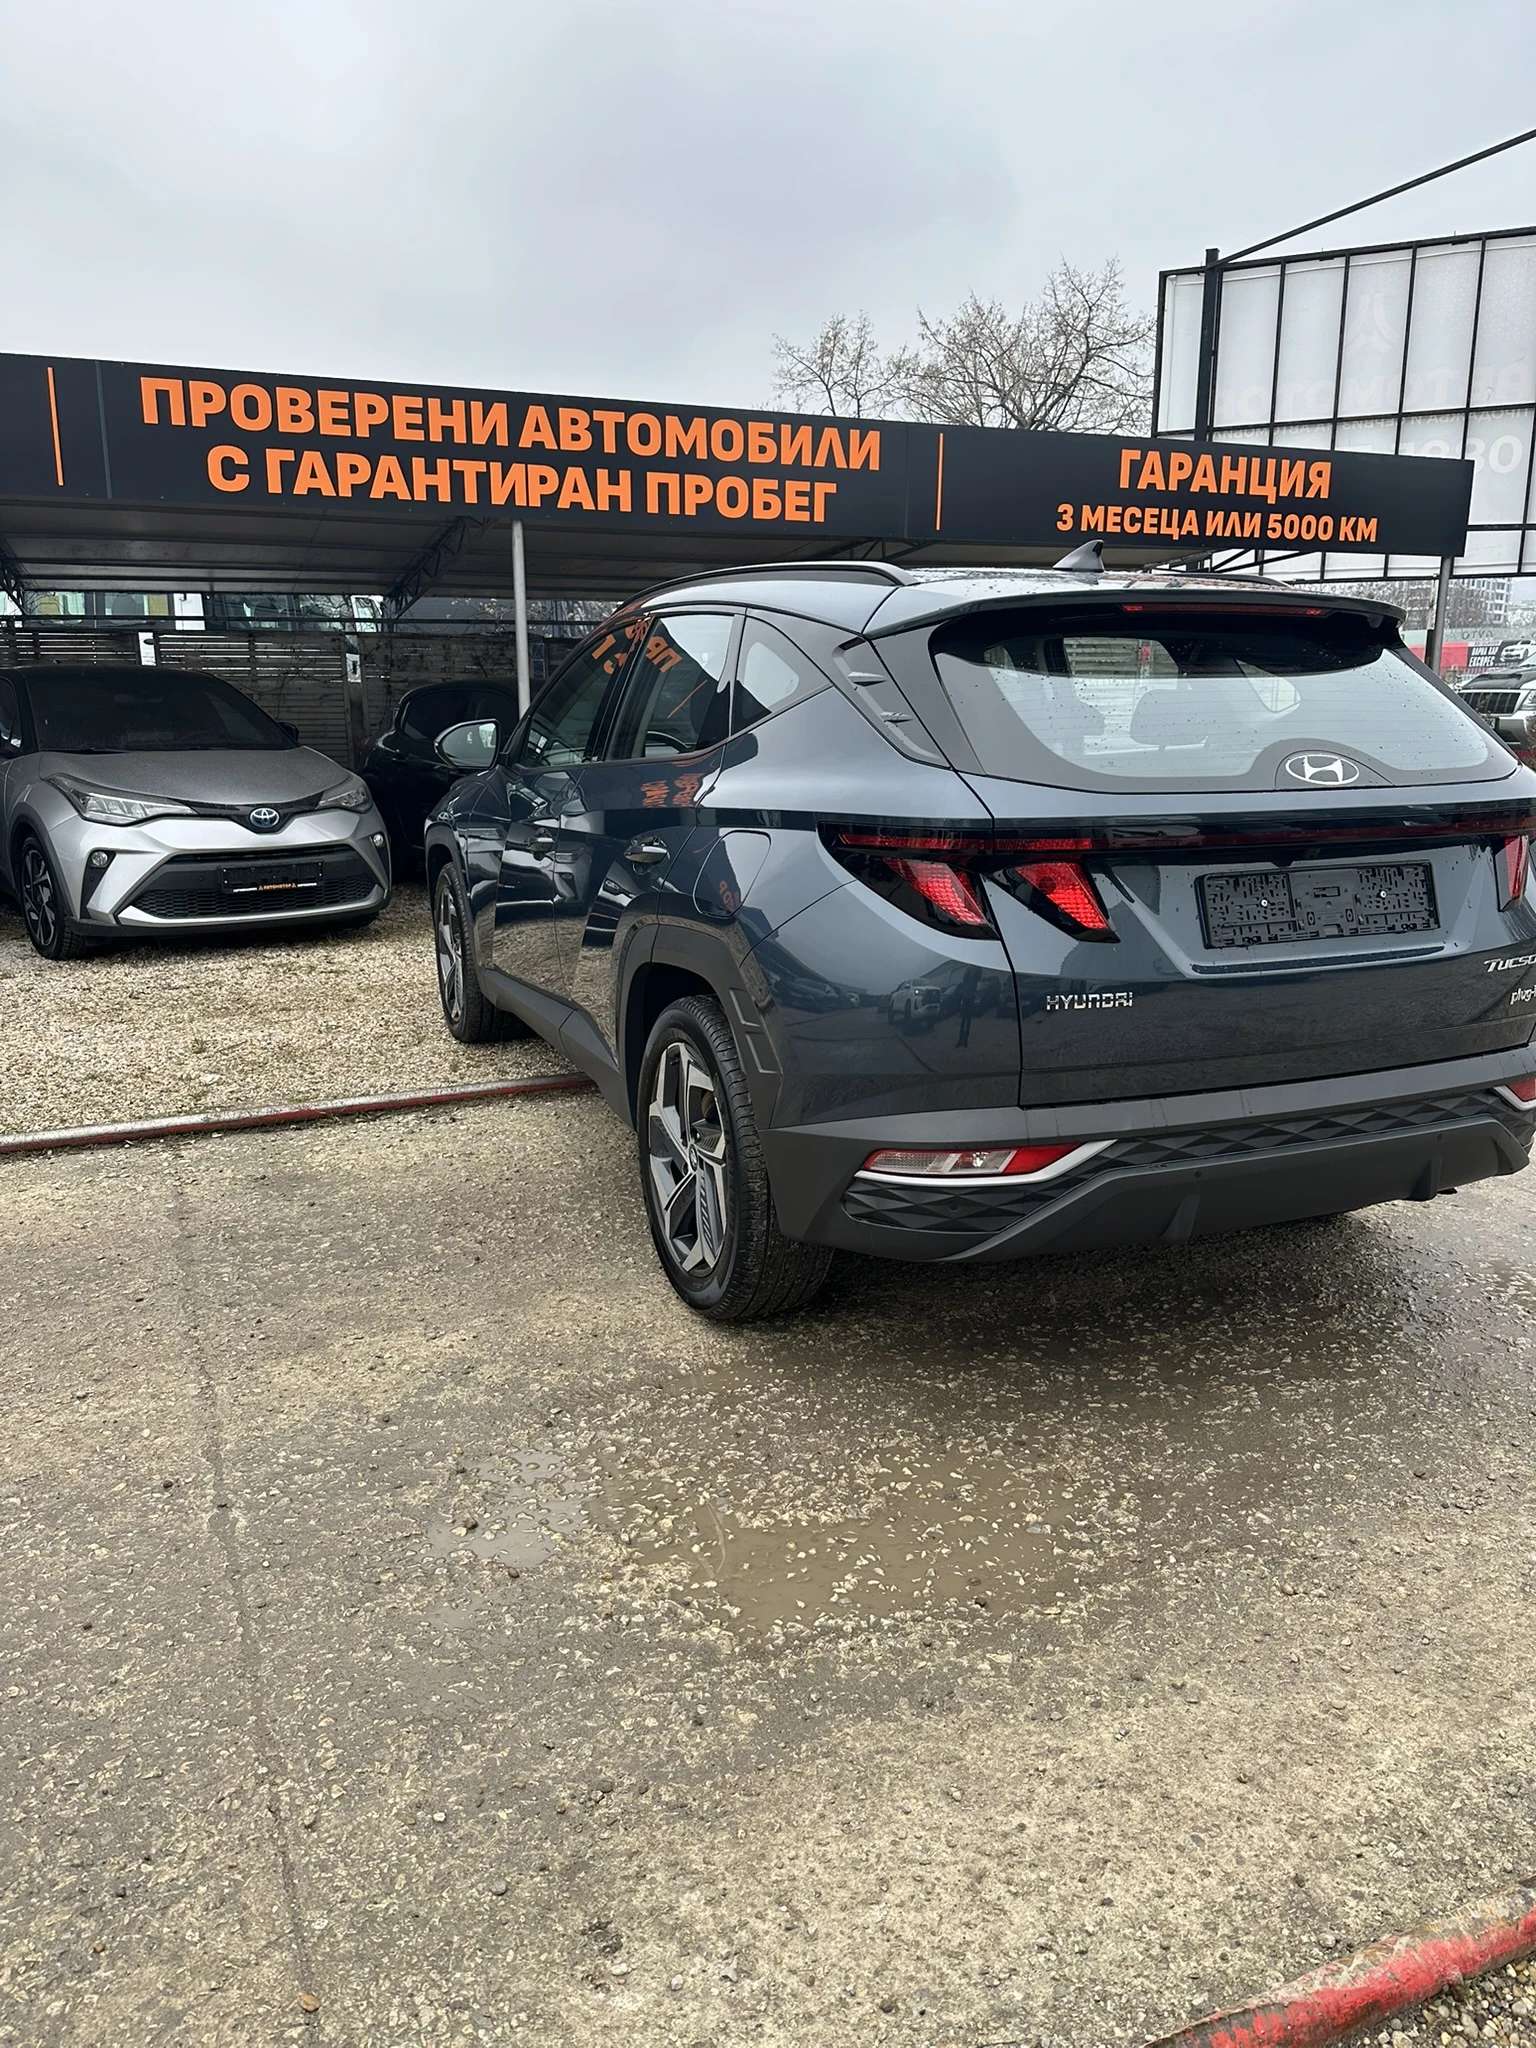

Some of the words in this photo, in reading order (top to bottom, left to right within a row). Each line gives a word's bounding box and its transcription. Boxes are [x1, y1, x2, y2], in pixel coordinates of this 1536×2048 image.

[140, 376, 509, 446] ПРОВЕРЕНИ
[518, 404, 881, 471] АВТОМОБИЛИ
[207, 445, 249, 492] С
[265, 448, 632, 512] ГАРАНТИРАН
[646, 471, 837, 523] ПРОБЕГ
[1119, 448, 1332, 505] ГАРАНЦИЯ
[1056, 504, 1074, 531] 3
[1080, 505, 1199, 540] МЕСЕЦА
[1205, 511, 1262, 539] ИЛИ
[1267, 513, 1335, 542] 5000
[1339, 517, 1379, 543] КМ
[1045, 991, 1134, 1012] HYUNDAI
